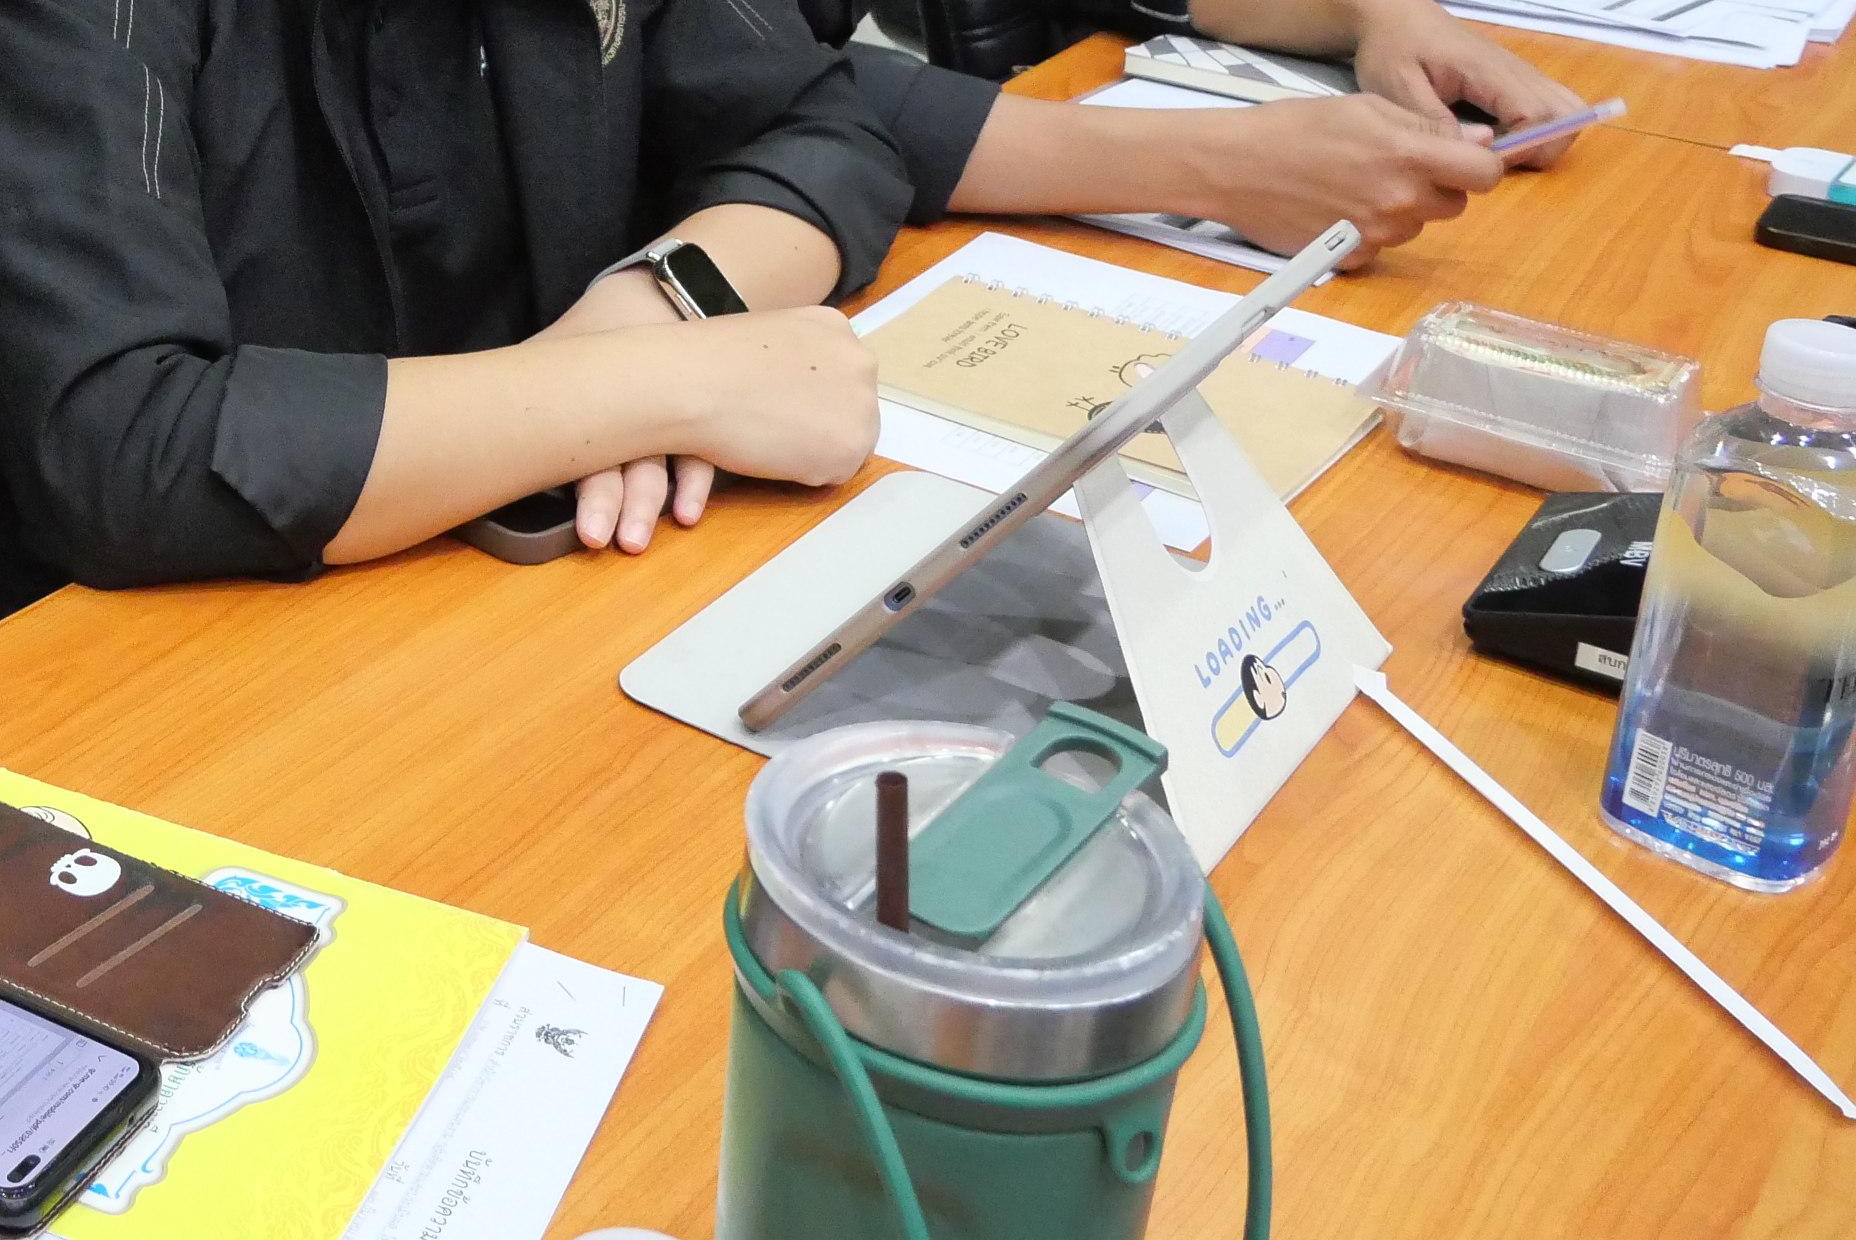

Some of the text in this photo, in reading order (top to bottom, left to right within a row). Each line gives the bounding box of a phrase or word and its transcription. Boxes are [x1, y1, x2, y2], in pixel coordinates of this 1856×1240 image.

[985, 323, 1028, 349] LOVE
[956, 346, 997, 368] BIRD
[1734, 768, 1755, 787] 500
[495, 1006, 533, 1056] ส่วนราชการ
[420, 1150, 492, 1240] บันทึกข้อความ
